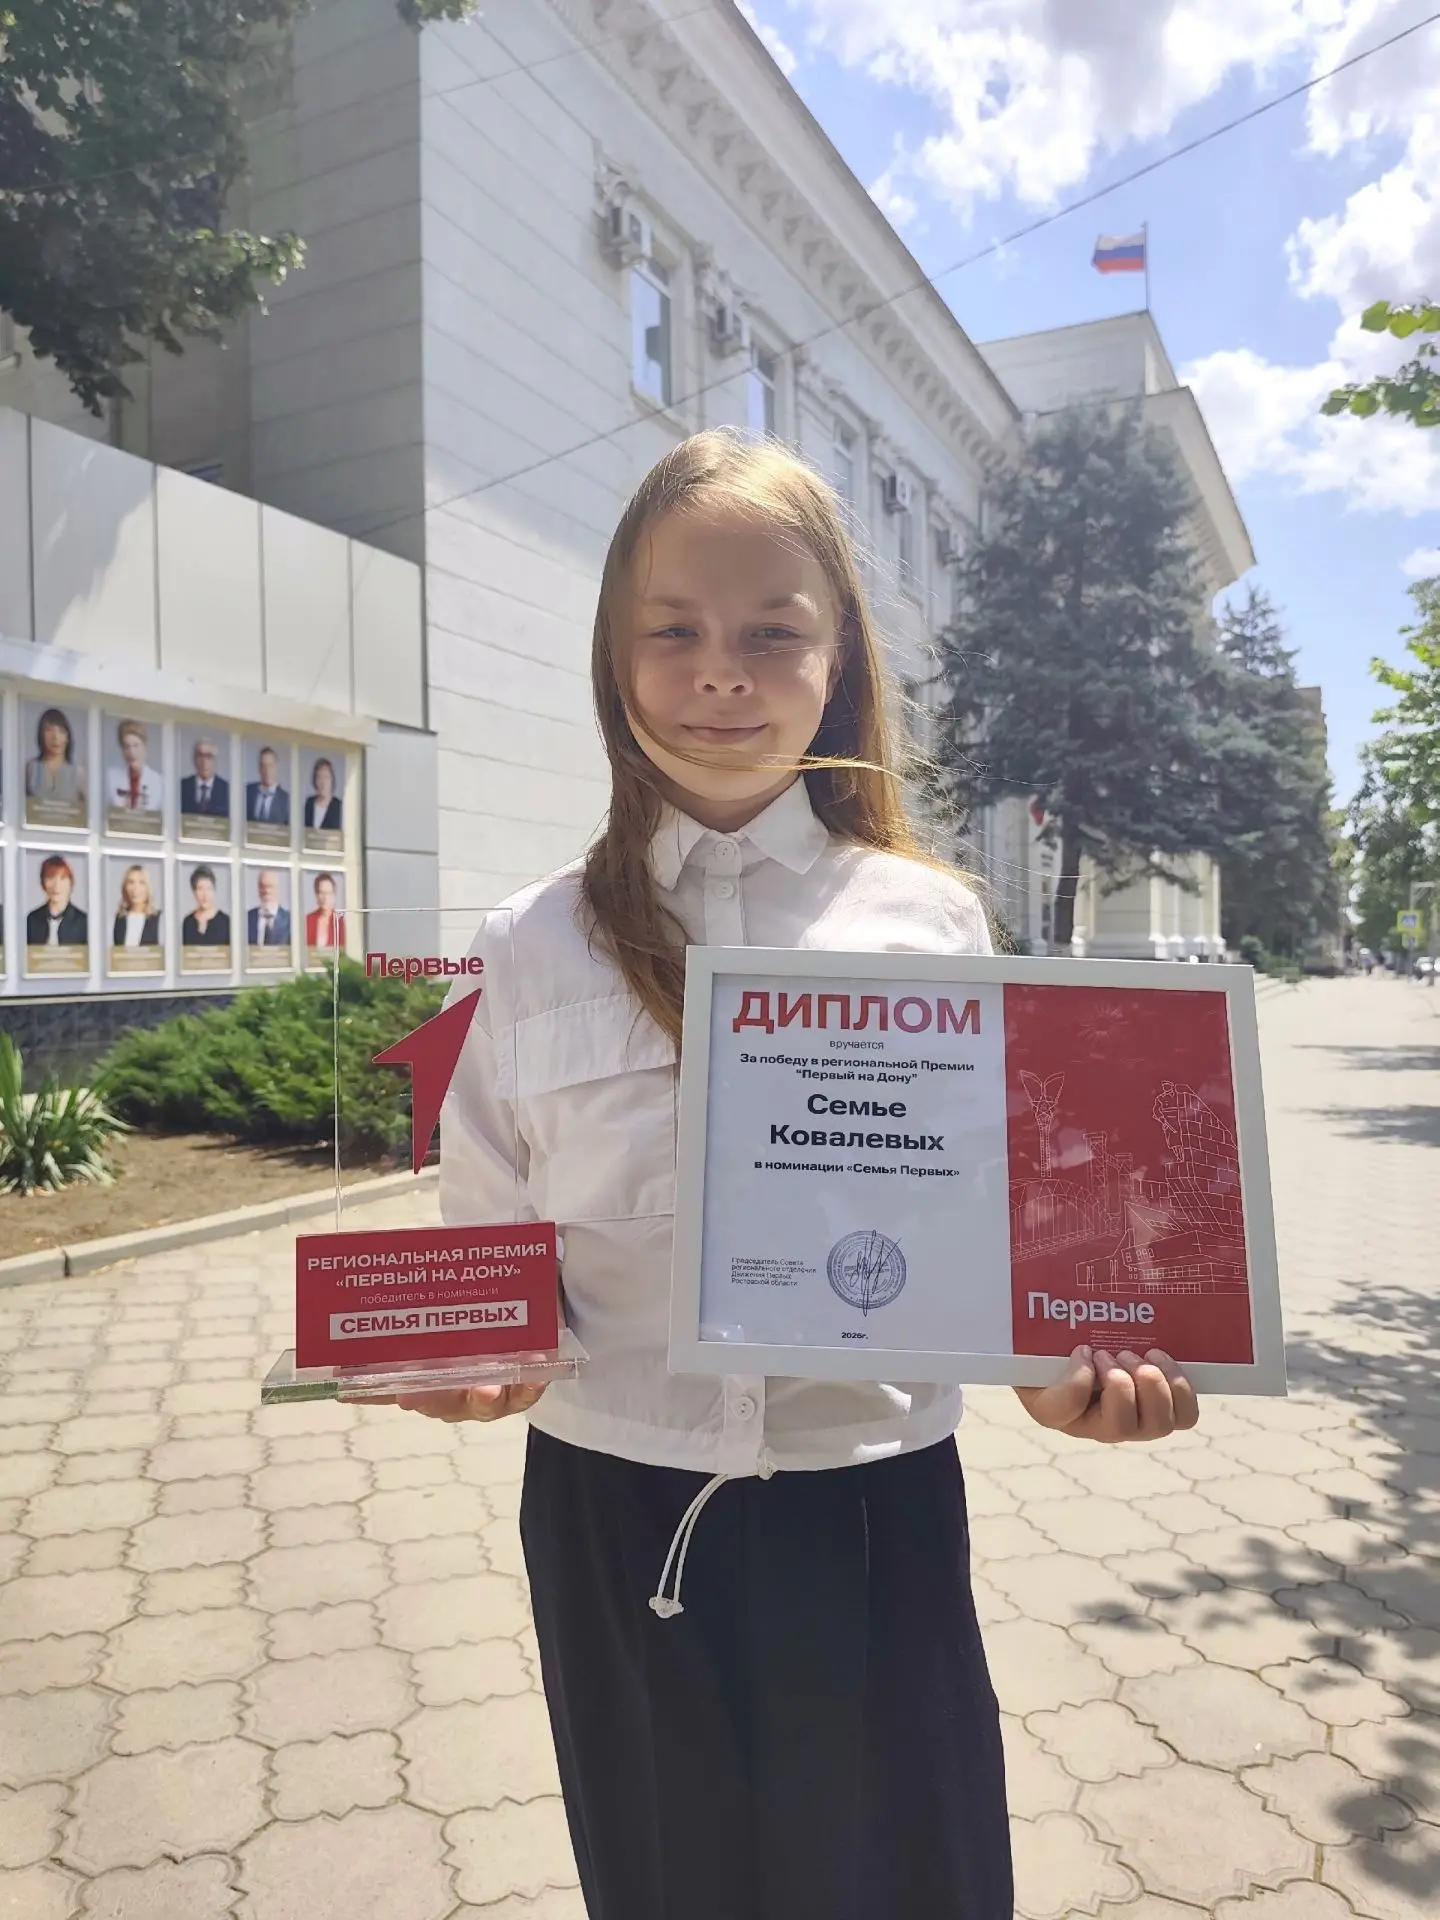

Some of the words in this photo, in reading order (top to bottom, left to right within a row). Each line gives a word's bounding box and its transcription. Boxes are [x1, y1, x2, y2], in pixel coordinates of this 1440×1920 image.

[365, 952, 485, 984] Первые
[732, 991, 981, 1034] ДИПЛОМ
[829, 1039, 884, 1051] вручается
[740, 1054, 757, 1064] За
[760, 1054, 808, 1067] победу
[811, 1058, 819, 1066] в
[822, 1058, 918, 1070] региональной
[921, 1060, 975, 1072] Премии
[858, 1074, 874, 1083] на
[807, 1093, 907, 1118] Семье
[770, 1124, 945, 1151] Ковалевых
[754, 1160, 762, 1169] в
[765, 1161, 844, 1175] номинации
[847, 1163, 897, 1175] «Семья
[900, 1165, 960, 1177] Первых»
[307, 1248, 464, 1271] РЕГИОНАЛЬНАЯ
[468, 1242, 547, 1260] ПРЕМИЯ
[336, 1267, 427, 1288] «ПЕРВЫЙ
[432, 1268, 457, 1283] НА
[461, 1264, 521, 1283] ДОНУ»
[360, 1291, 425, 1305] победитель
[428, 1292, 435, 1300] в
[437, 1287, 499, 1301] номинации
[340, 1312, 420, 1334] СЕМЬЯ
[425, 1306, 519, 1327] ПЕРВЫХ
[1027, 1291, 1155, 1329] Первые
